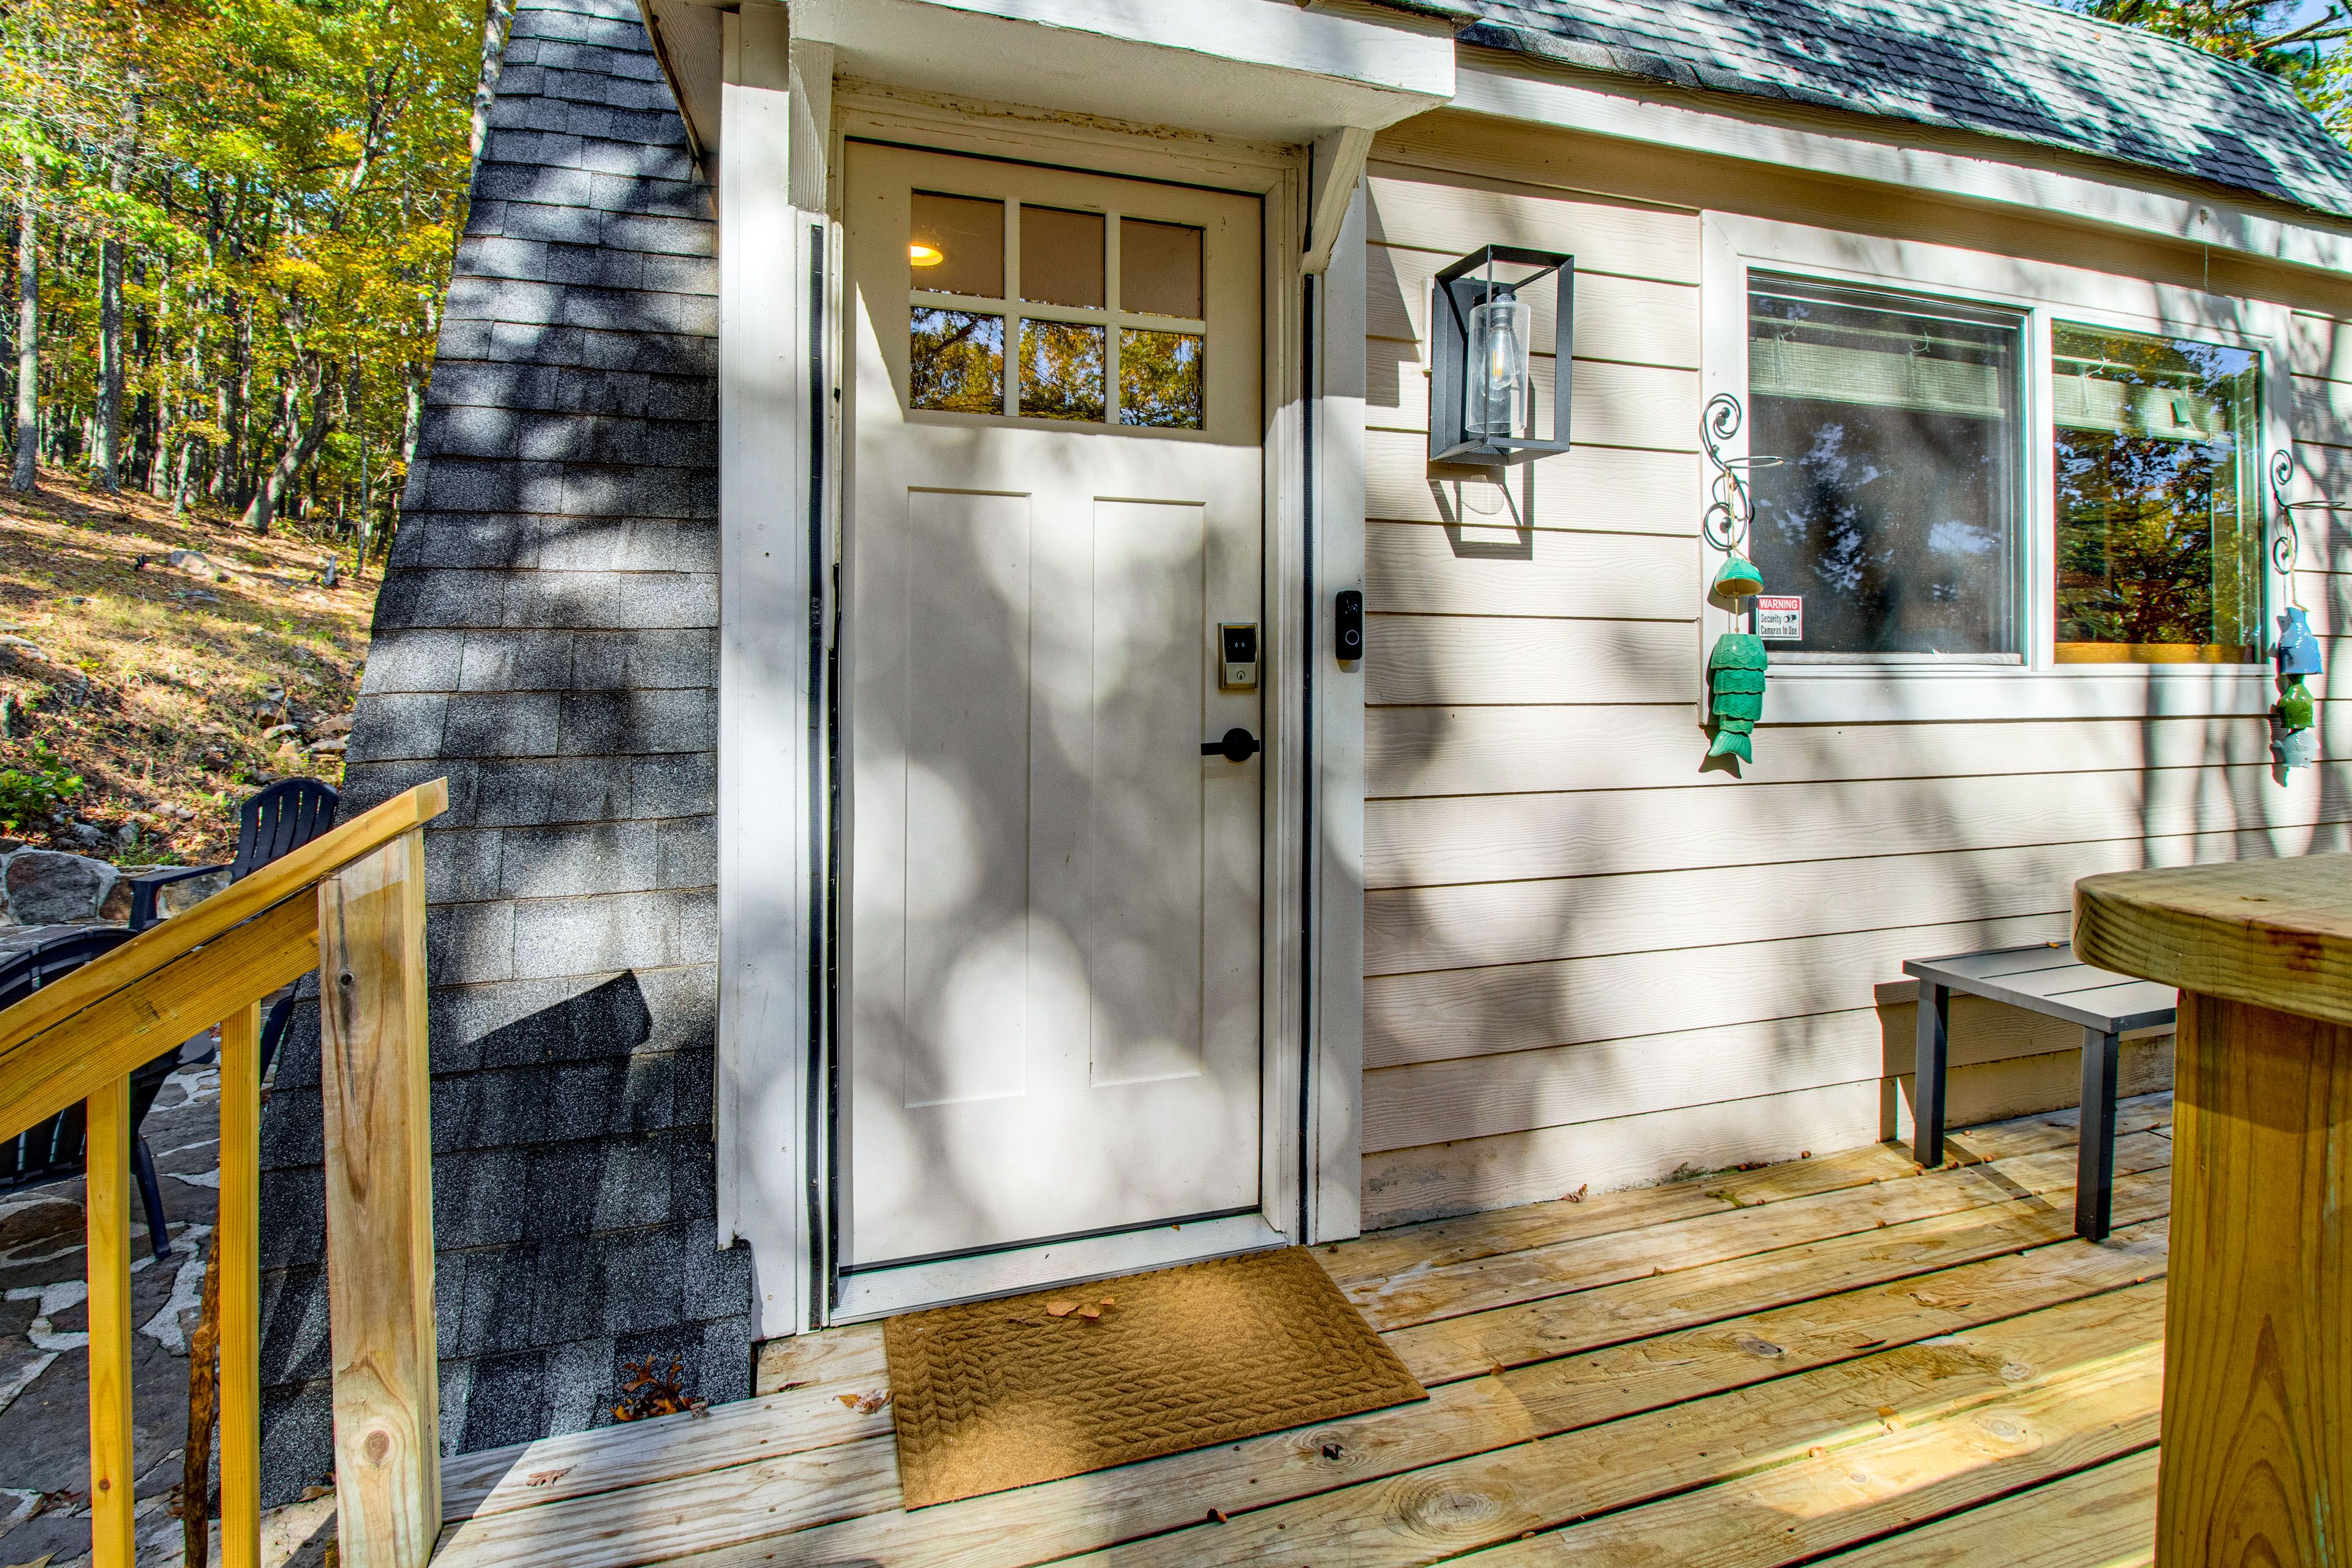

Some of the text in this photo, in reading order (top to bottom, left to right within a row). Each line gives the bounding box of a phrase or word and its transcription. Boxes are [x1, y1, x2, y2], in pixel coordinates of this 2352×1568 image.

[1759, 599, 1798, 609] WARNING
[1761, 614, 1782, 625] Security
[1761, 625, 1797, 635] Cameras In Use
